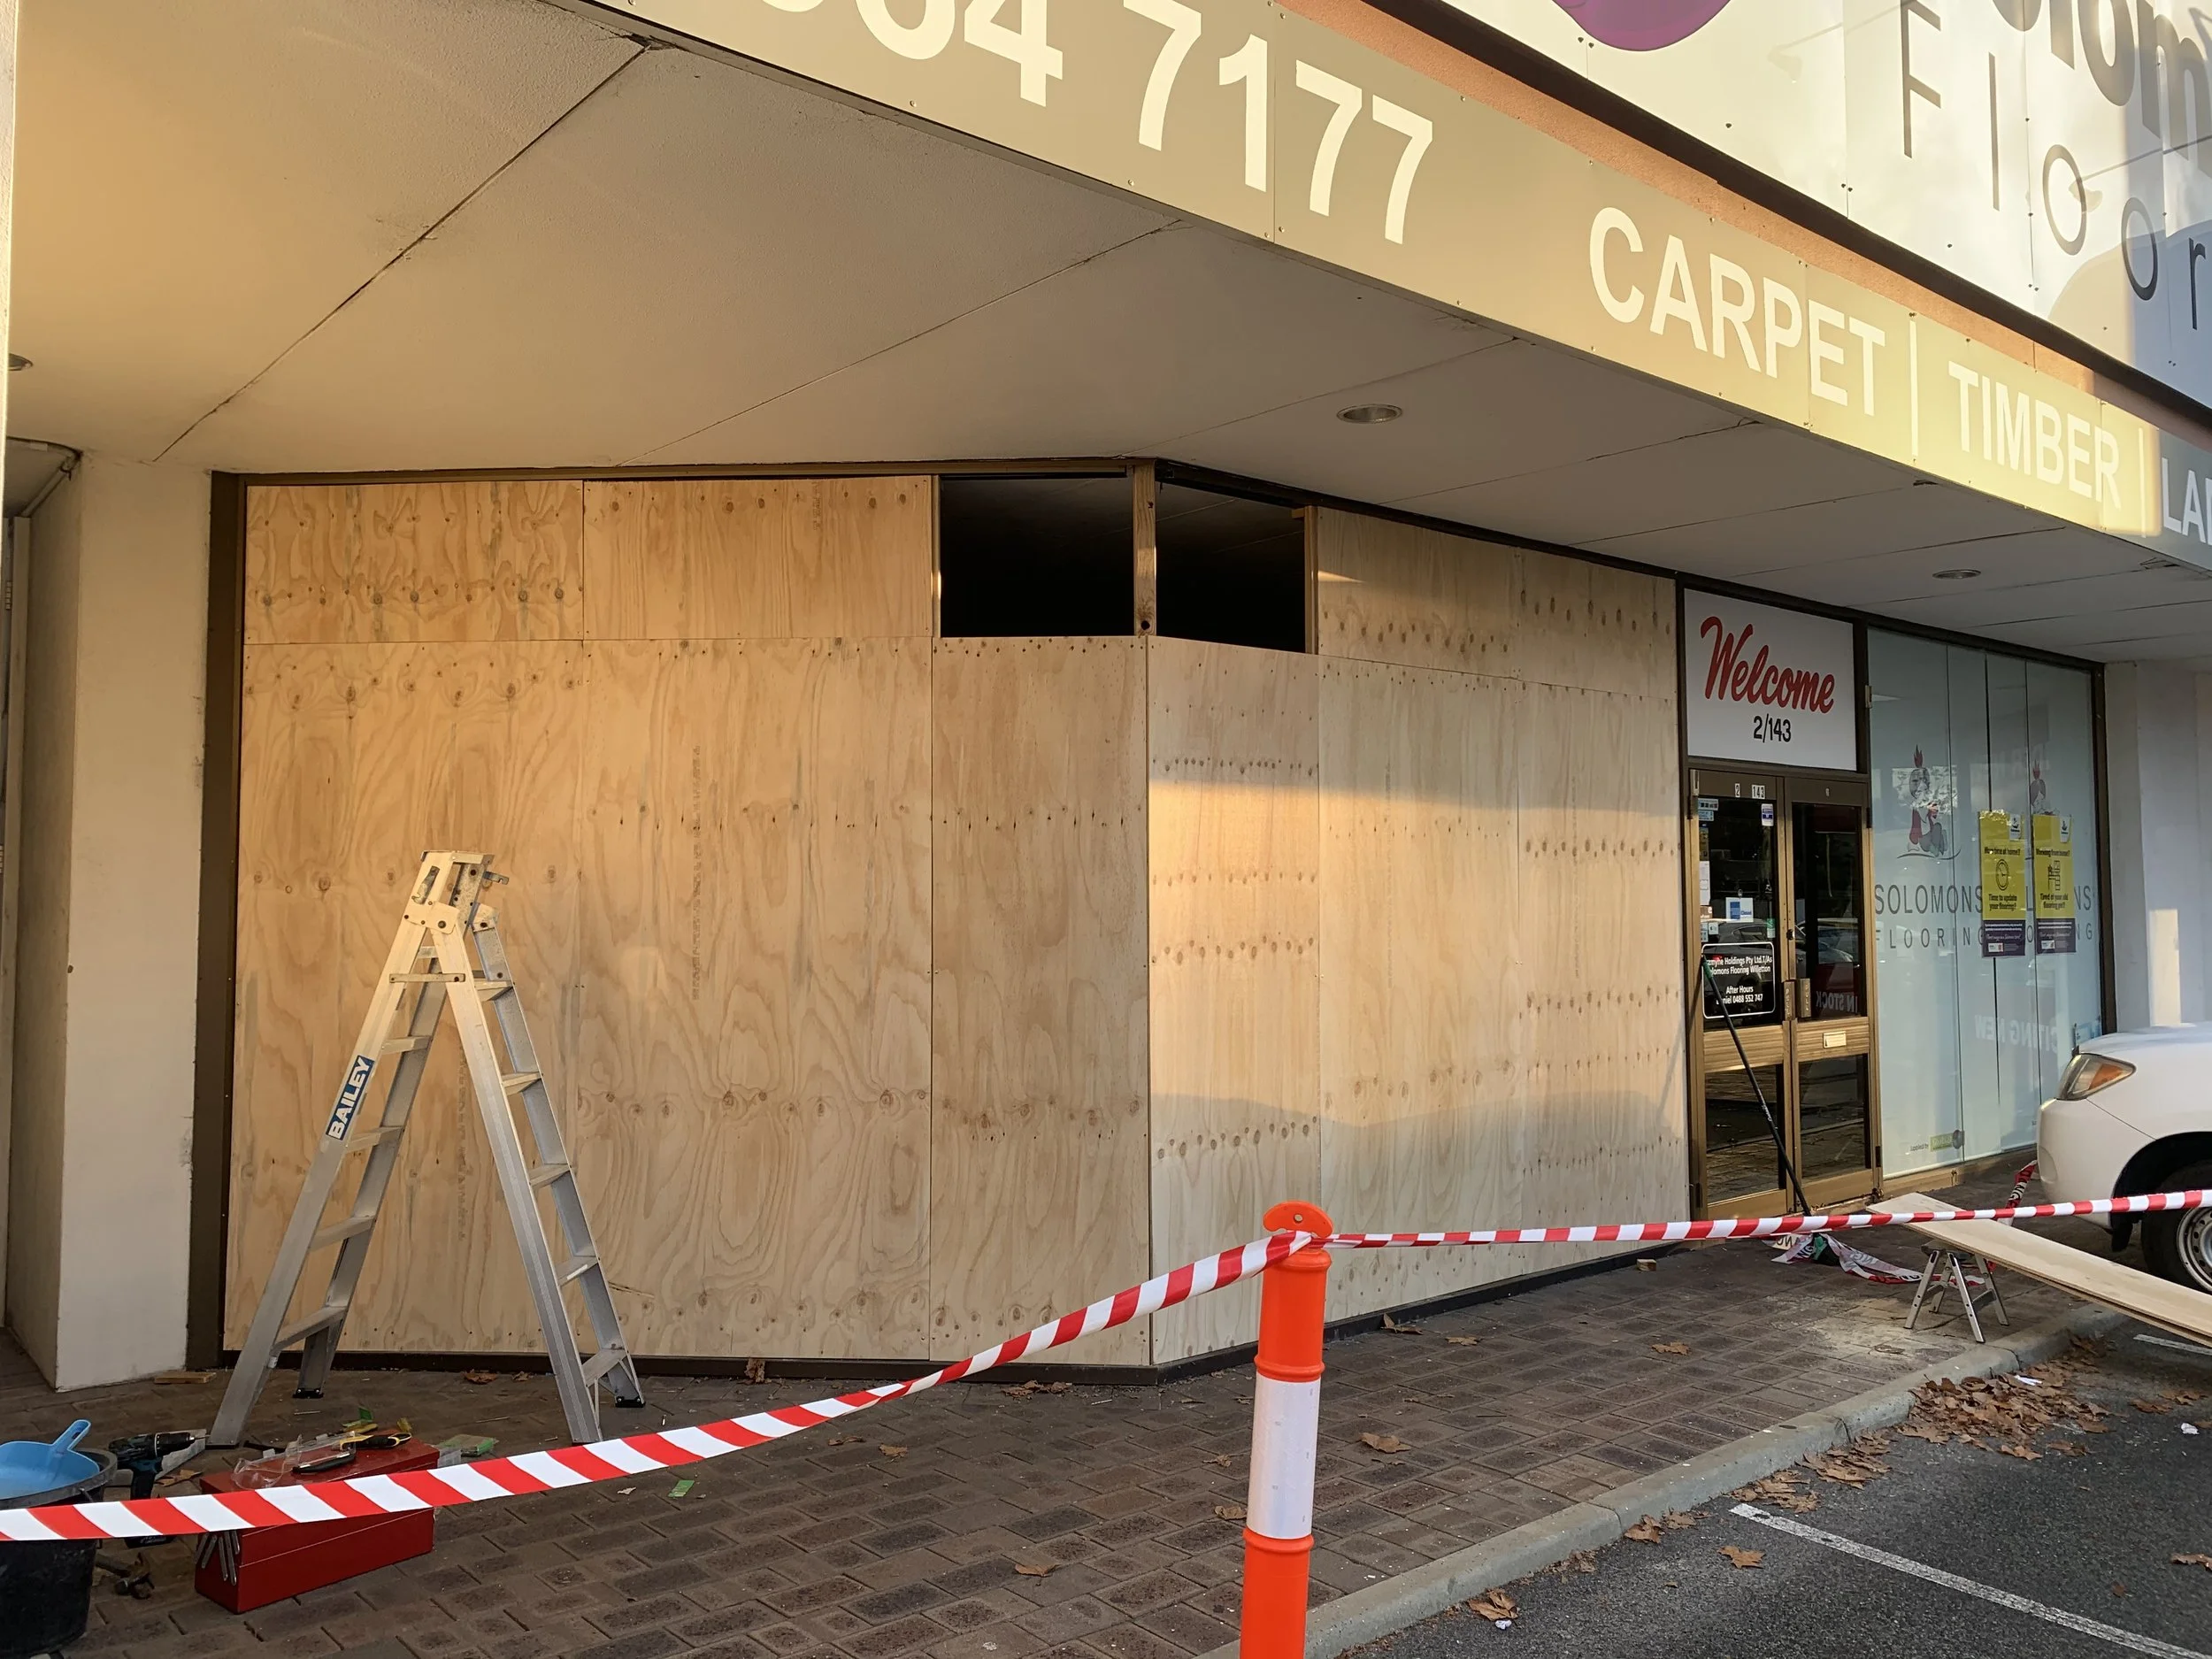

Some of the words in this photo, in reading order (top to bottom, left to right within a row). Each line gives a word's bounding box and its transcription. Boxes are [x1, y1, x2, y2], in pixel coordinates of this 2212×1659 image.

[1589, 207, 1886, 417] CARPET
[1947, 360, 2121, 509] TIMBER
[2162, 457, 2212, 546] LA
[1701, 616, 1835, 713] Welcome
[1753, 713, 1792, 743] 2/143
[1752, 785, 1765, 798] 143
[1875, 884, 1982, 915] SOLOMONS
[1730, 966, 1749, 975] Flooring
[1725, 986, 1739, 995] After
[1740, 985, 1754, 994] Hours
[327, 1056, 370, 1140] BAILEY
